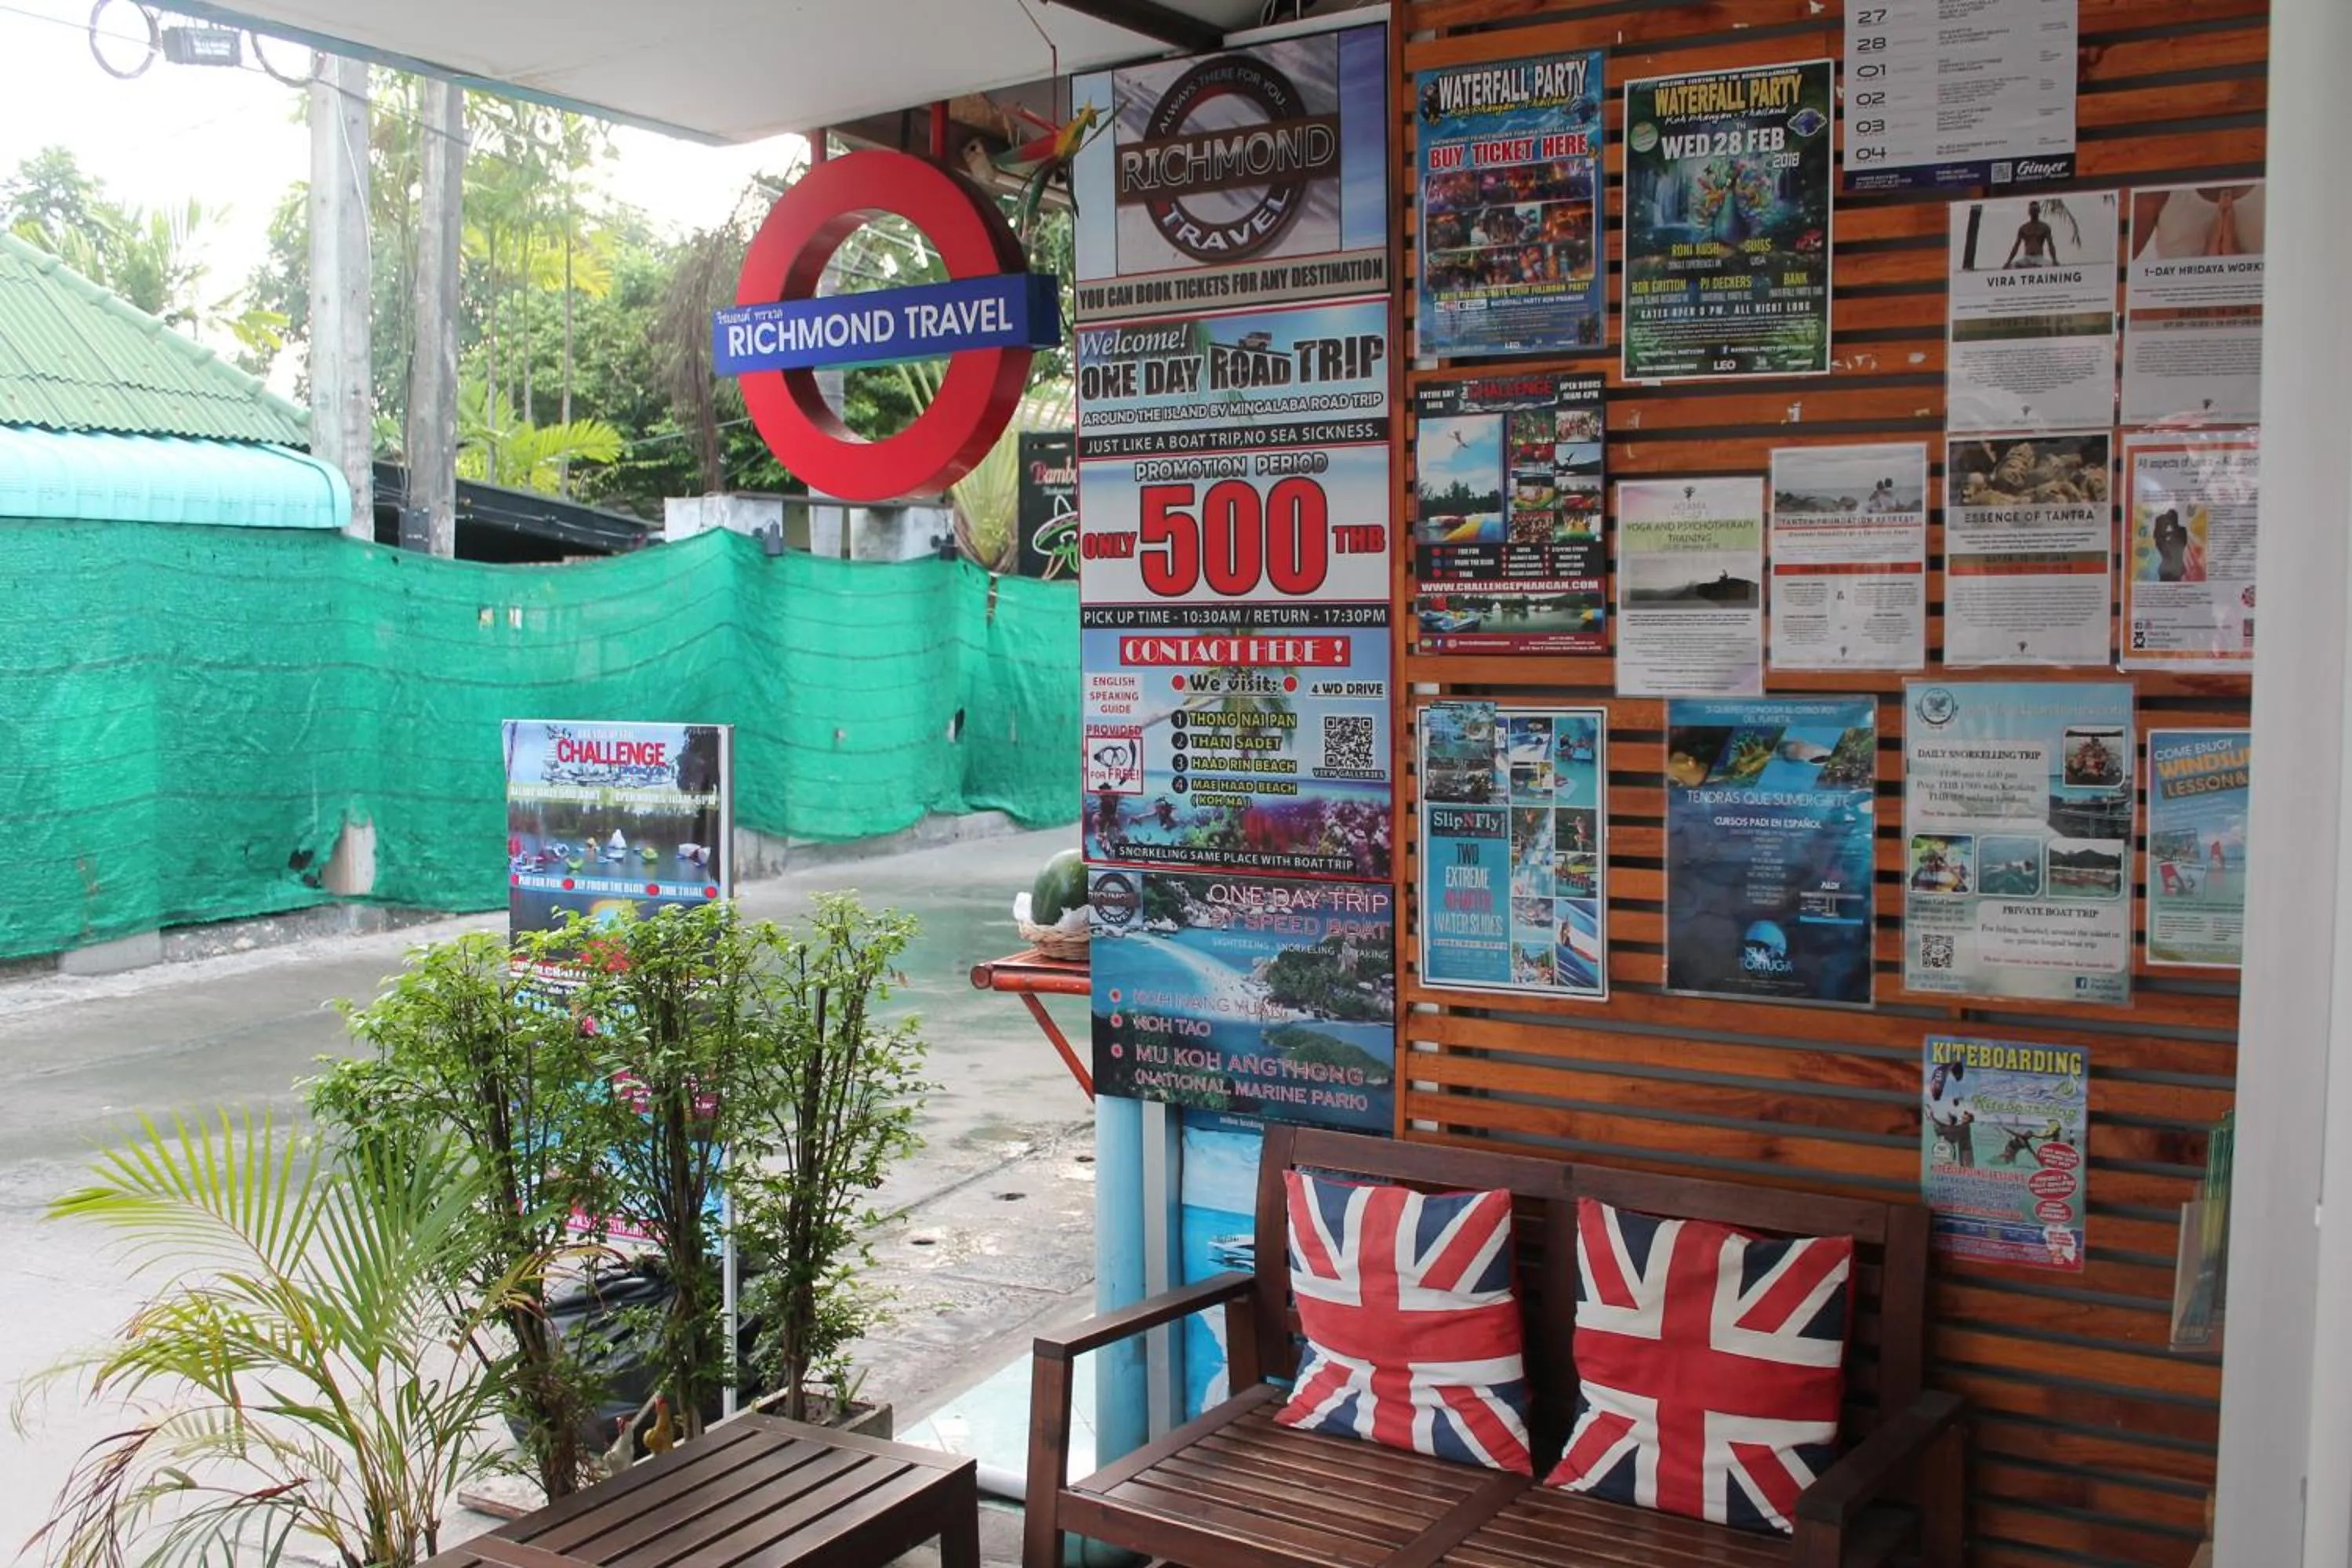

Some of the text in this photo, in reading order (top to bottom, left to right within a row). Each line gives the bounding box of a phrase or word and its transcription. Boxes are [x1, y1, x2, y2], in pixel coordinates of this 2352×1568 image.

[1857, 9, 1886, 24] 27
[1857, 38, 1886, 51] 28
[1857, 64, 1886, 77] 01
[1439, 60, 1587, 110] WATERFALL PARTY
[1159, 67, 1261, 136] ALWAYS THERE FOR
[1655, 73, 1802, 117] WATERFALL PARTY
[1856, 92, 1886, 105] 02
[1856, 119, 1885, 133] 03
[1430, 132, 1588, 168] BUY TICKET HERE
[1662, 127, 1785, 160] WED 28 FEB
[1122, 124, 1335, 194] RICHMOND
[1773, 152, 1799, 168] 2018
[1856, 147, 1886, 161] 04
[2016, 161, 2067, 176] Ginger
[1161, 187, 1290, 251] TRAVEL
[2179, 264, 2224, 276] HRIDAYA
[1080, 259, 1383, 310] YOU CAN BOOK TICKETS FOR ANY DESTINATION
[1987, 272, 2082, 288] VIRA TRAINING
[728, 298, 1013, 357] RICHMOND TRAVEL
[1079, 324, 1188, 358] Welcome!
[1081, 334, 1385, 401] ONE DAY ROAD TRIP
[1714, 360, 1736, 370] LEO
[1468, 380, 1552, 398] CHALLENGE
[1082, 392, 1383, 427] AROUND THE ISLAND BY MINGALABA ROAD TRIP
[1087, 437, 1120, 454] JUST
[1123, 435, 1152, 452] LIKE
[1155, 434, 1165, 449] A
[1169, 432, 1207, 448] BOAT
[1270, 427, 1297, 444] SEA
[1302, 423, 1378, 441] SICKNESS.
[1134, 452, 1328, 481] PROMOTION PERIOD
[1626, 519, 1755, 532] YOGA AND PSYCHOTHERAPY
[1965, 510, 2095, 524] ESSENCE OF TANTRA
[1082, 476, 1385, 597] ONLY 500 THB
[1668, 533, 1711, 543] TRAINING
[1083, 608, 1386, 625] PICK UP TIME 10:30AM RETURN 17:30PM
[1125, 640, 1242, 664] CONTACT
[1249, 640, 1322, 664] HERE
[1092, 677, 1135, 688] ENGLISH
[1190, 675, 1279, 691] We visit:
[1311, 684, 1384, 695] 4 WD DRIVE
[1089, 691, 1139, 702] SPEAKING
[1100, 704, 1131, 714] GUIDE
[1190, 712, 1298, 728] THONG NAI PAN
[1086, 724, 1142, 735] PROVIDED
[1190, 735, 1282, 750] THAN SADET
[2154, 739, 2233, 761] COME ENJOY
[557, 740, 666, 766] CHALLENGE
[1918, 749, 1945, 758] DAILY
[2019, 751, 2041, 760] TRIP
[1191, 757, 1297, 774] HAAD RIN BEACH
[1091, 771, 1106, 781] FOR
[1191, 779, 1297, 795] MAE HAAD BEACH
[1687, 790, 1739, 804] TENDRAS
[1744, 792, 1771, 805] QUE
[1434, 811, 1499, 831] SlipNFly
[1715, 817, 1821, 829] CURSOS PADI EN ESPAÑOL
[1119, 845, 1354, 871] SNORKELING SAME PLACE WITH BOAT TRIP
[1456, 844, 1479, 864] TWO
[1446, 866, 1490, 888] EXTREME
[1209, 884, 1388, 913] ONE DAY TRIP
[2002, 906, 2100, 918] PRIVATE BOAT TRIP
[1246, 914, 1319, 935] SPEED
[1327, 918, 1391, 941] BOAT
[1134, 1016, 1211, 1036] KOH TAO
[1135, 1044, 1364, 1086] MU KOH ANGTHONG
[1932, 1042, 2082, 1075] KITEBOARDING
[1235, 1081, 1311, 1106] MARINE
